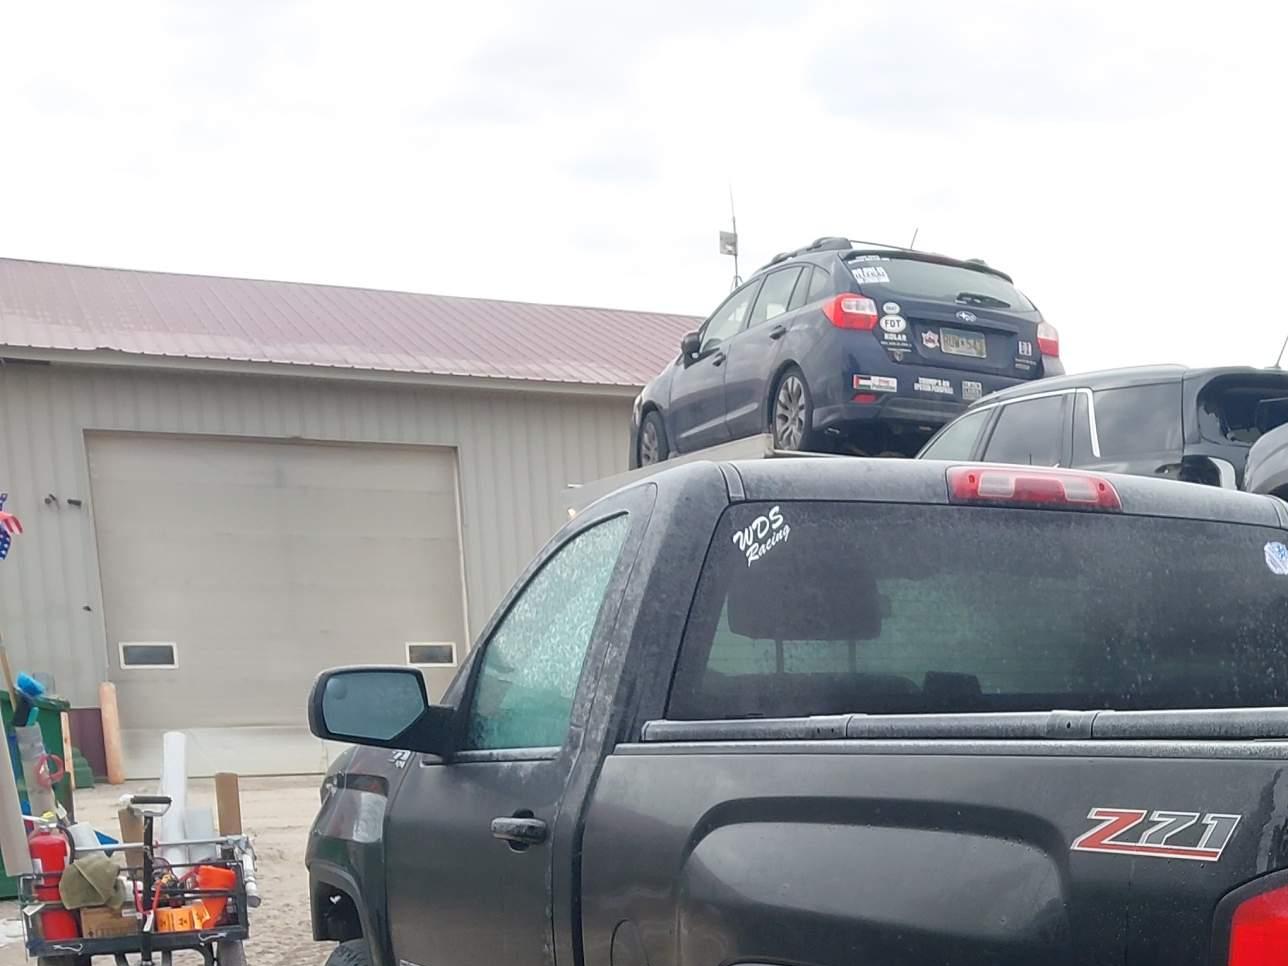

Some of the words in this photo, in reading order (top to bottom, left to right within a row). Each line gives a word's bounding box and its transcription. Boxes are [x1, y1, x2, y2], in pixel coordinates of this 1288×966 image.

[732, 505, 783, 551] WDS
[745, 524, 791, 567] Racing
[1070, 807, 1242, 862] Z71
